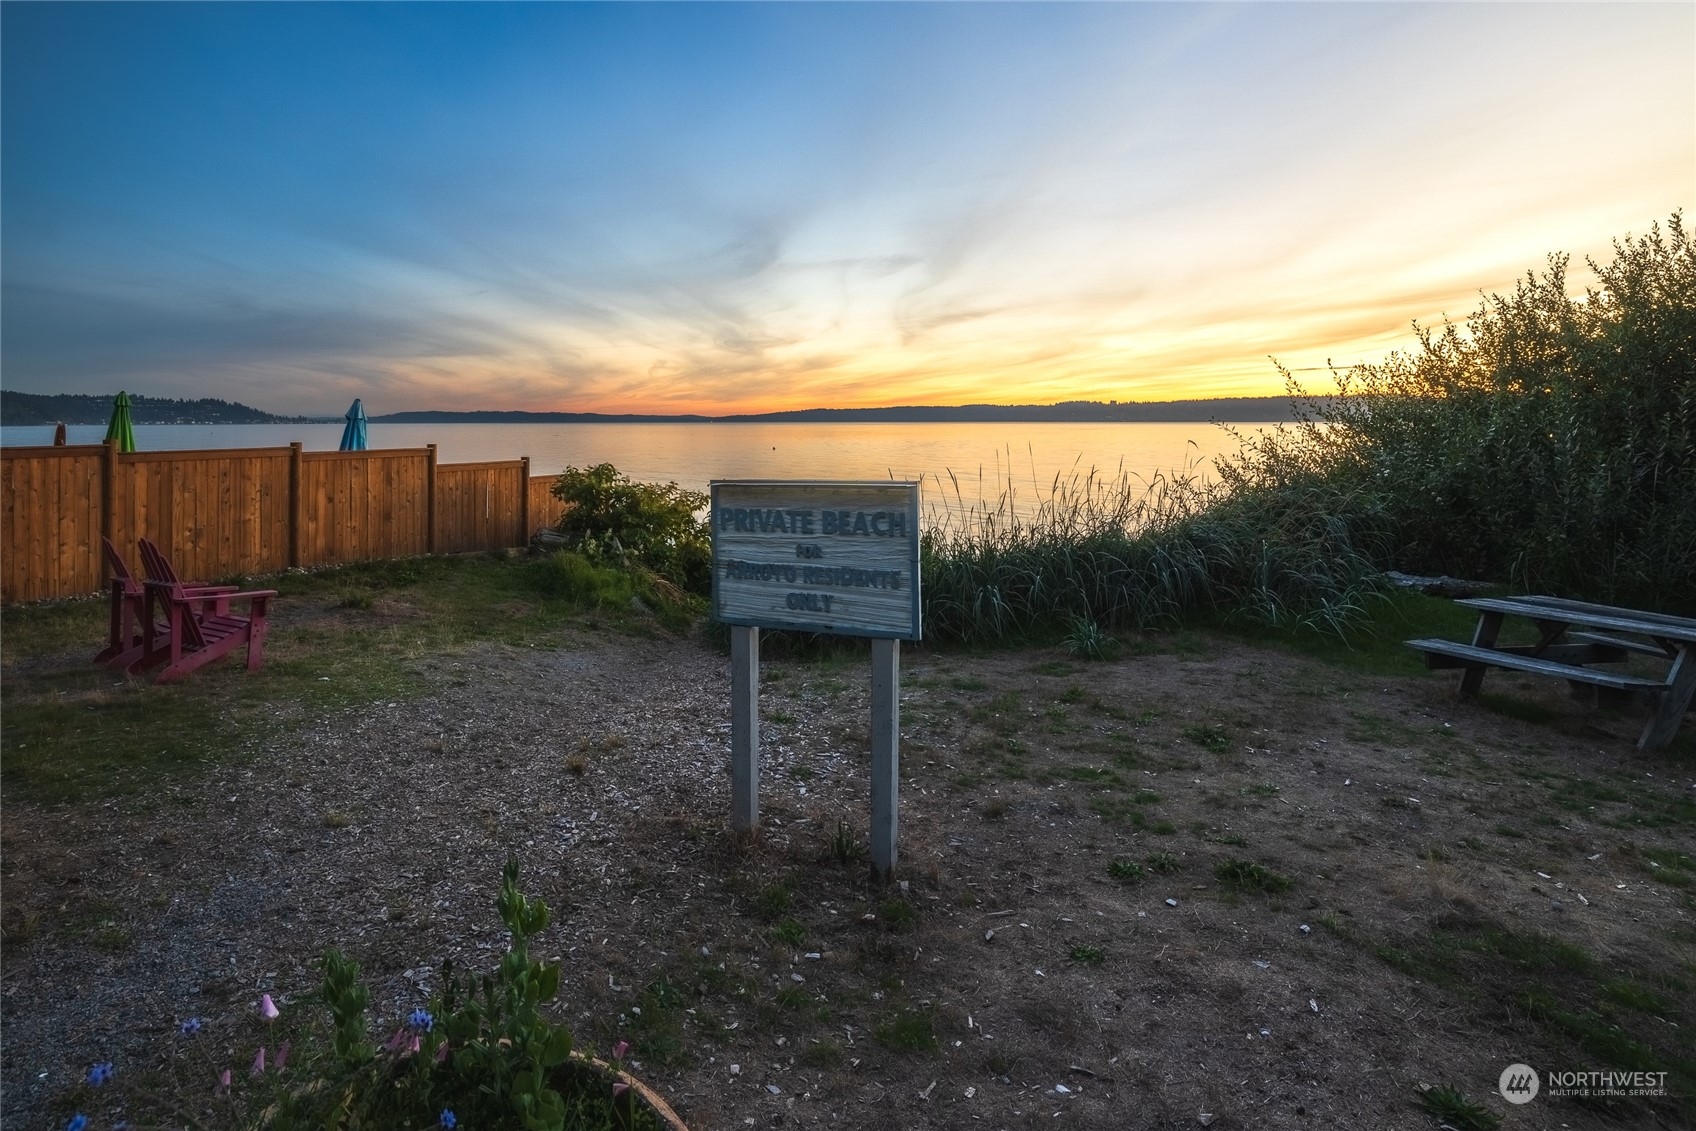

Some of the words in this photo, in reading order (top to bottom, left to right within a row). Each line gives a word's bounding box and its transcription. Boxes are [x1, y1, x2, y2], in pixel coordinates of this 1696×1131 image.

[720, 508, 814, 534] PRIVATE
[822, 510, 906, 537] BEACH
[796, 543, 824, 559] FOR
[725, 560, 797, 583] ARROYO
[803, 565, 901, 590] RESIDENTS
[786, 592, 834, 613] ONLY
